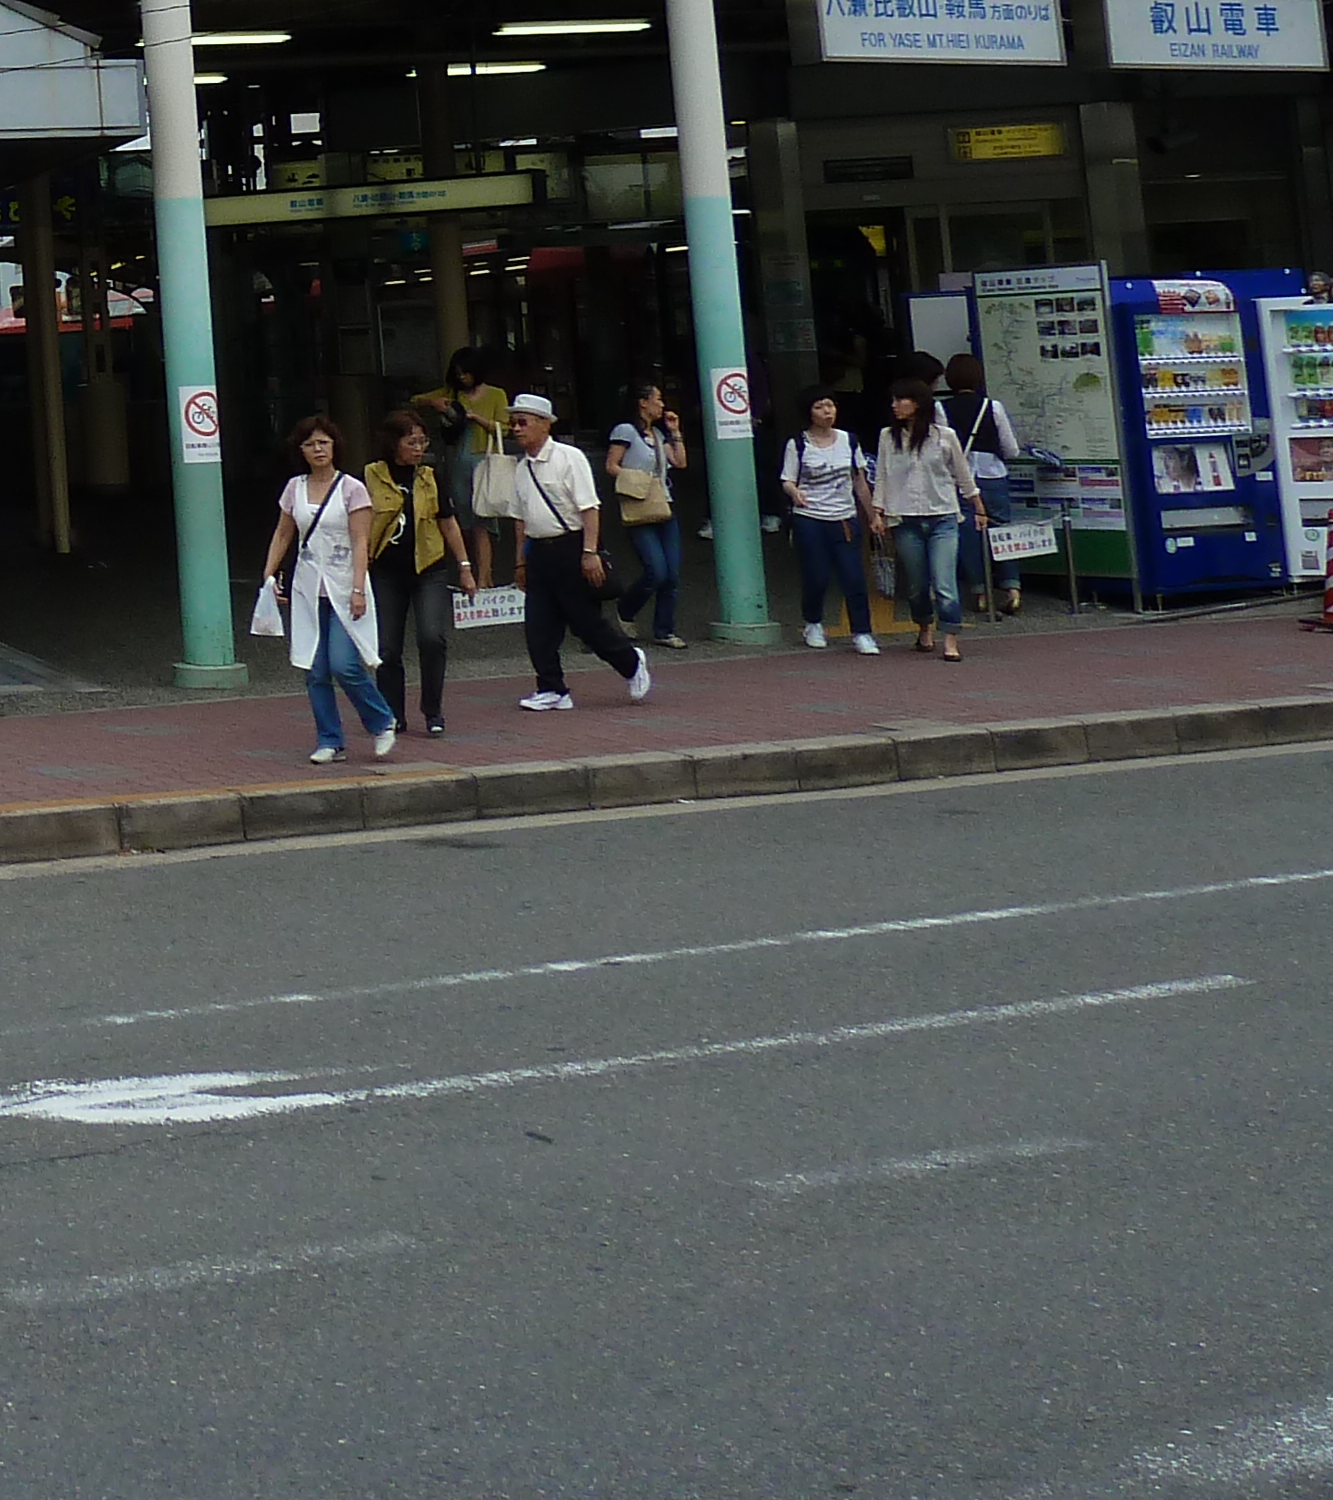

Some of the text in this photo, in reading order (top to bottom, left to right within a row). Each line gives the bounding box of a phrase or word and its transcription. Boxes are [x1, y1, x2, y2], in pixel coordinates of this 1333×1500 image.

[1150, 0, 1280, 37] 叡山電車
[860, 32, 886, 48] FOR
[889, 32, 921, 49] YASE
[974, 34, 1025, 50] KURAMA
[1170, 43, 1260, 59] EIZAN RAILWAY
